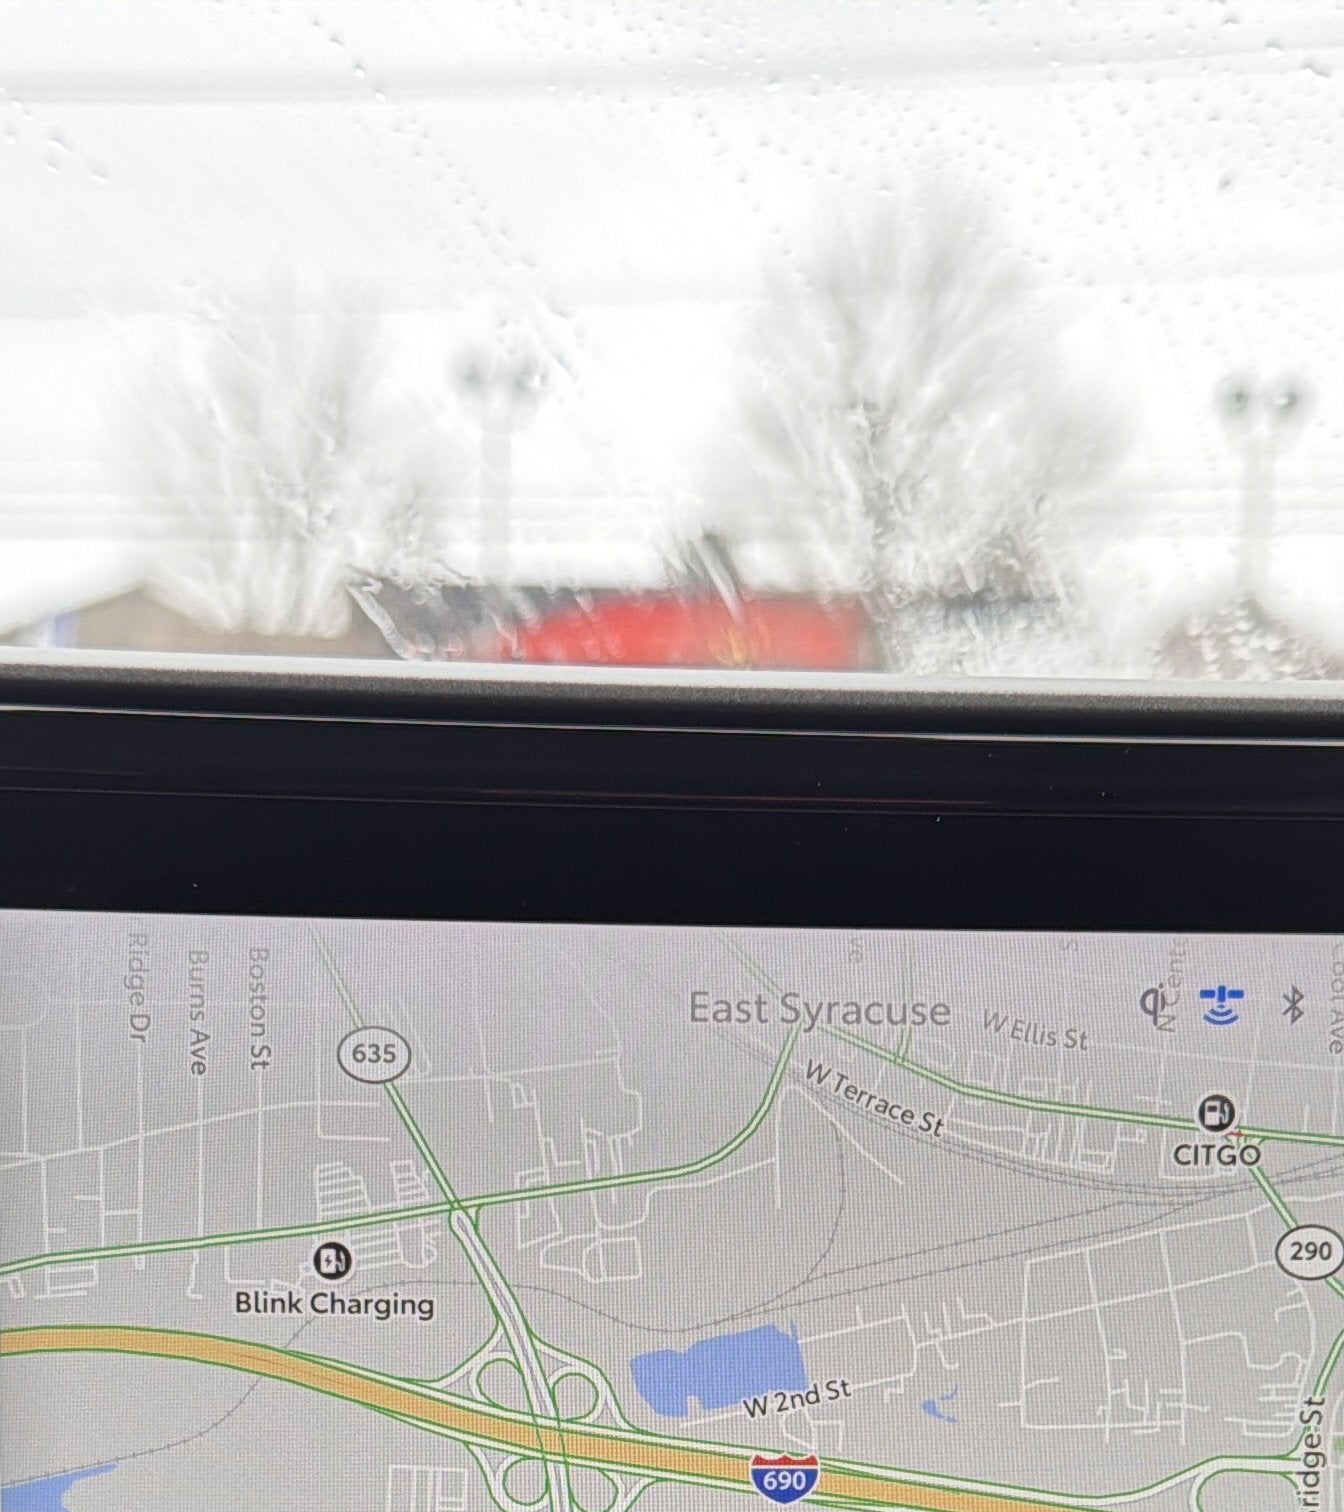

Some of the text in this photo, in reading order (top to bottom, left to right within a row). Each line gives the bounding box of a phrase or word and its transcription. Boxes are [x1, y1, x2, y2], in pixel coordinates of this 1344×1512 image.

[123, 931, 150, 1007] Ridge
[188, 949, 212, 1077] Burns Ave
[248, 947, 272, 1071] Boston St
[689, 991, 952, 1032] East Syracuse
[130, 1014, 151, 1044] Dr
[981, 1008, 1090, 1051] W Ellis St
[351, 1043, 397, 1065] 635
[803, 1058, 946, 1138] W Terrace St
[1173, 1144, 1262, 1167] CITGO
[1289, 1242, 1334, 1261] 290
[235, 1291, 435, 1322] Blink Charging
[743, 1379, 852, 1420] W 2nd St
[1299, 1396, 1326, 1426] St
[762, 1471, 807, 1491] 690
